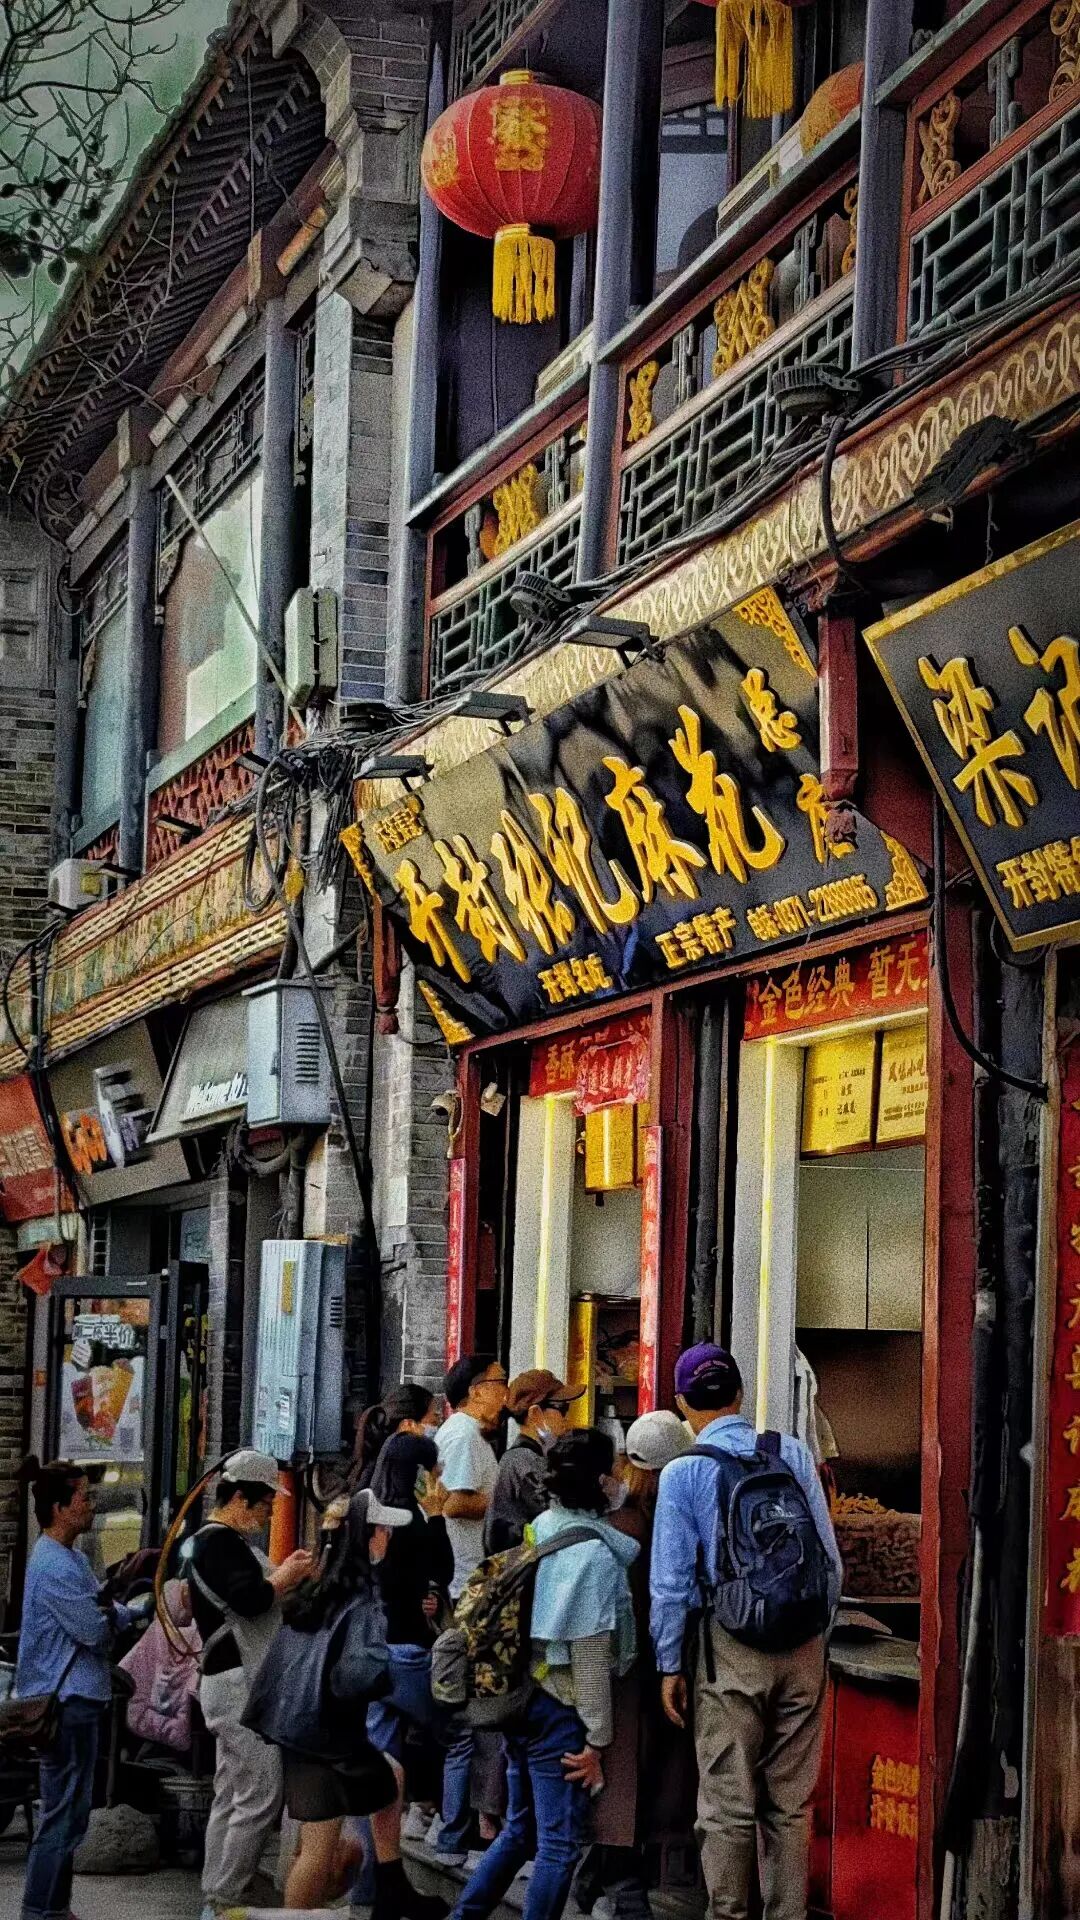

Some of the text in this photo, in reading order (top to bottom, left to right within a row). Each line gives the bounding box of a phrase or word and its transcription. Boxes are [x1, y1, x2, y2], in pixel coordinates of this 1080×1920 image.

[654, 906, 736, 970] 正宗特产
[867, 941, 928, 999] 暂无
[757, 956, 856, 1026] 金色经典
